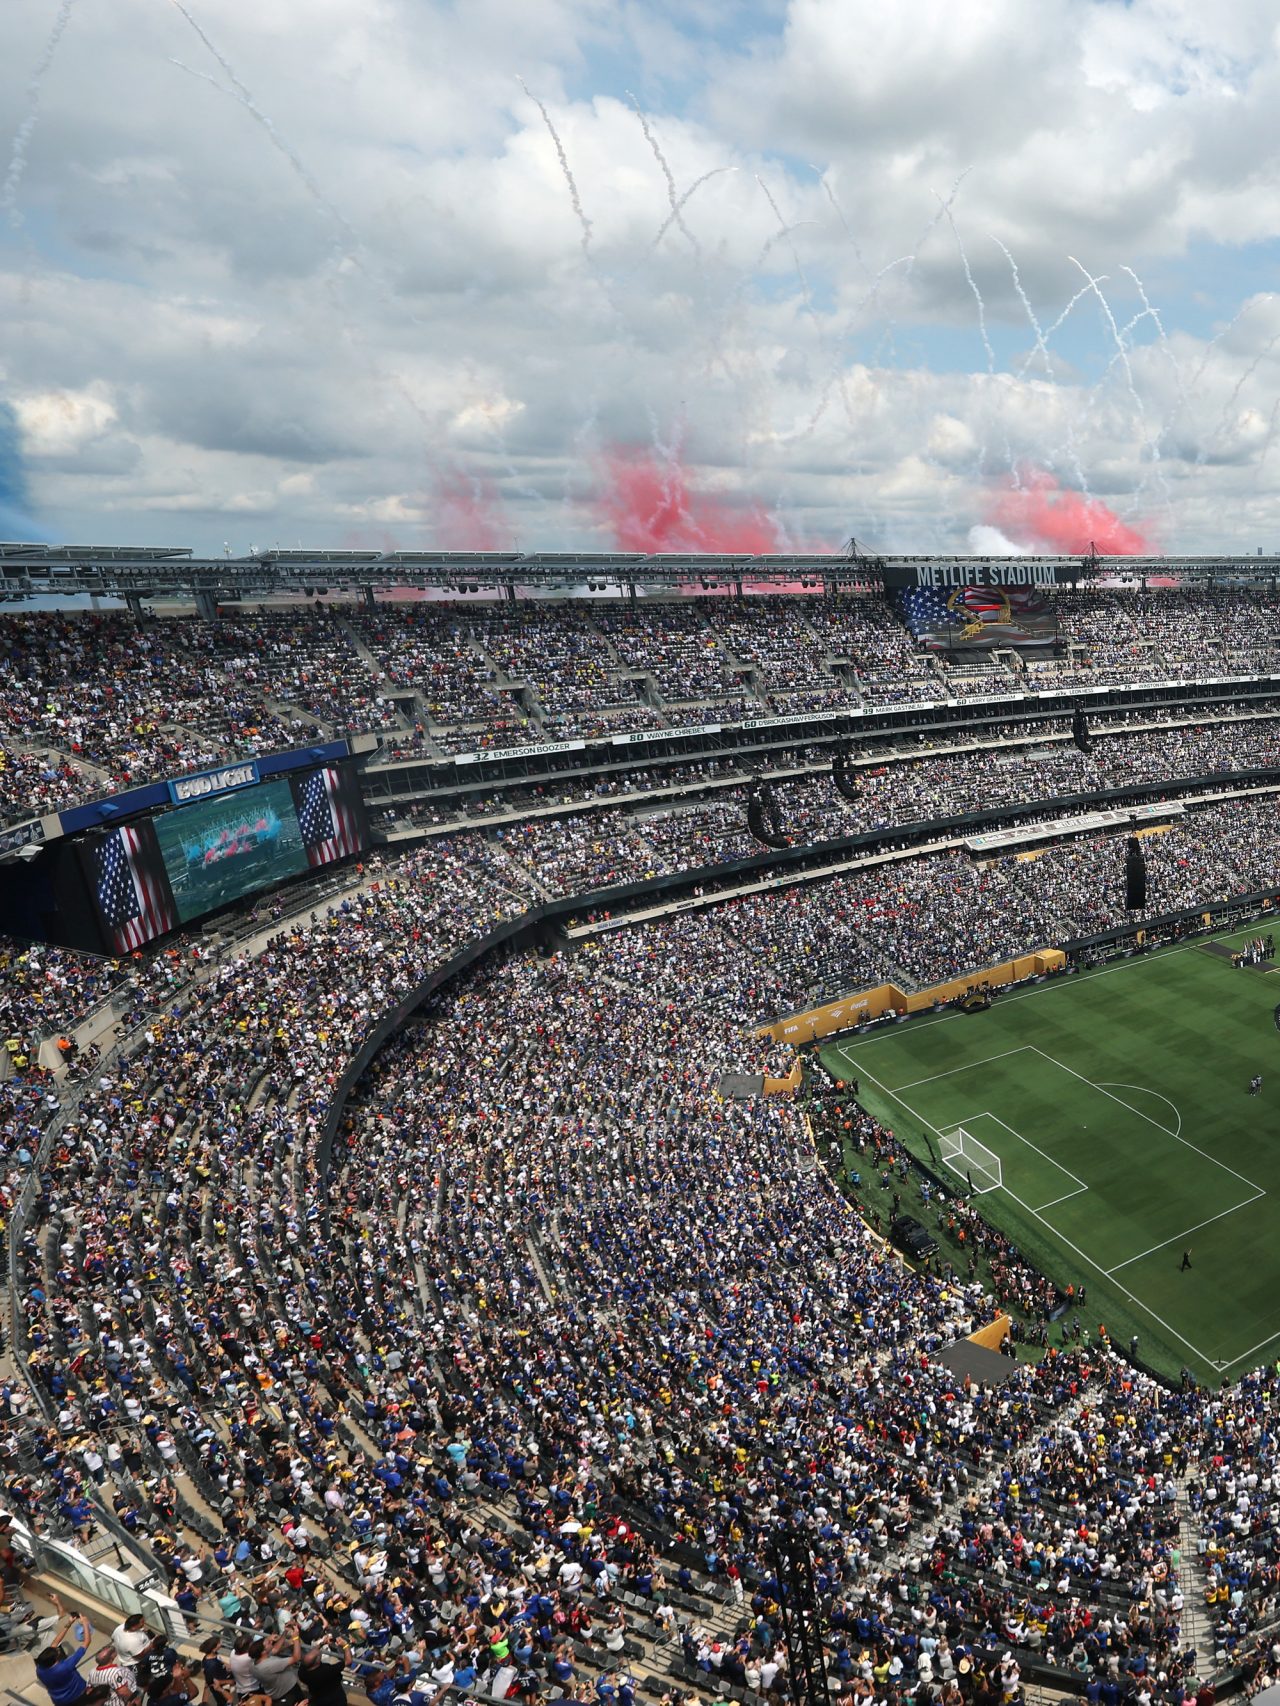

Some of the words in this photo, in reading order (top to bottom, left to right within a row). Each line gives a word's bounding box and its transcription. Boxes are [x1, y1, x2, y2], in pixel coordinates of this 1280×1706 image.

[917, 566, 985, 586] METLIFE
[989, 566, 1056, 586] STADIUM
[956, 698, 967, 706] 60
[986, 694, 1016, 703] GRANTHAM
[893, 703, 925, 711] GASTINEAU
[744, 720, 757, 729] 60
[629, 733, 644, 742] 80
[646, 730, 674, 740] WAYNE
[674, 726, 706, 738] CHREBET
[473, 752, 489, 762] 32
[493, 748, 537, 759] EMERSON
[536, 743, 570, 755] BOOZER
[175, 777, 211, 800] BUD
[209, 765, 255, 790] LIGHT
[608, 919, 623, 927] LIGHT
[783, 1025, 799, 1035] FIFA
